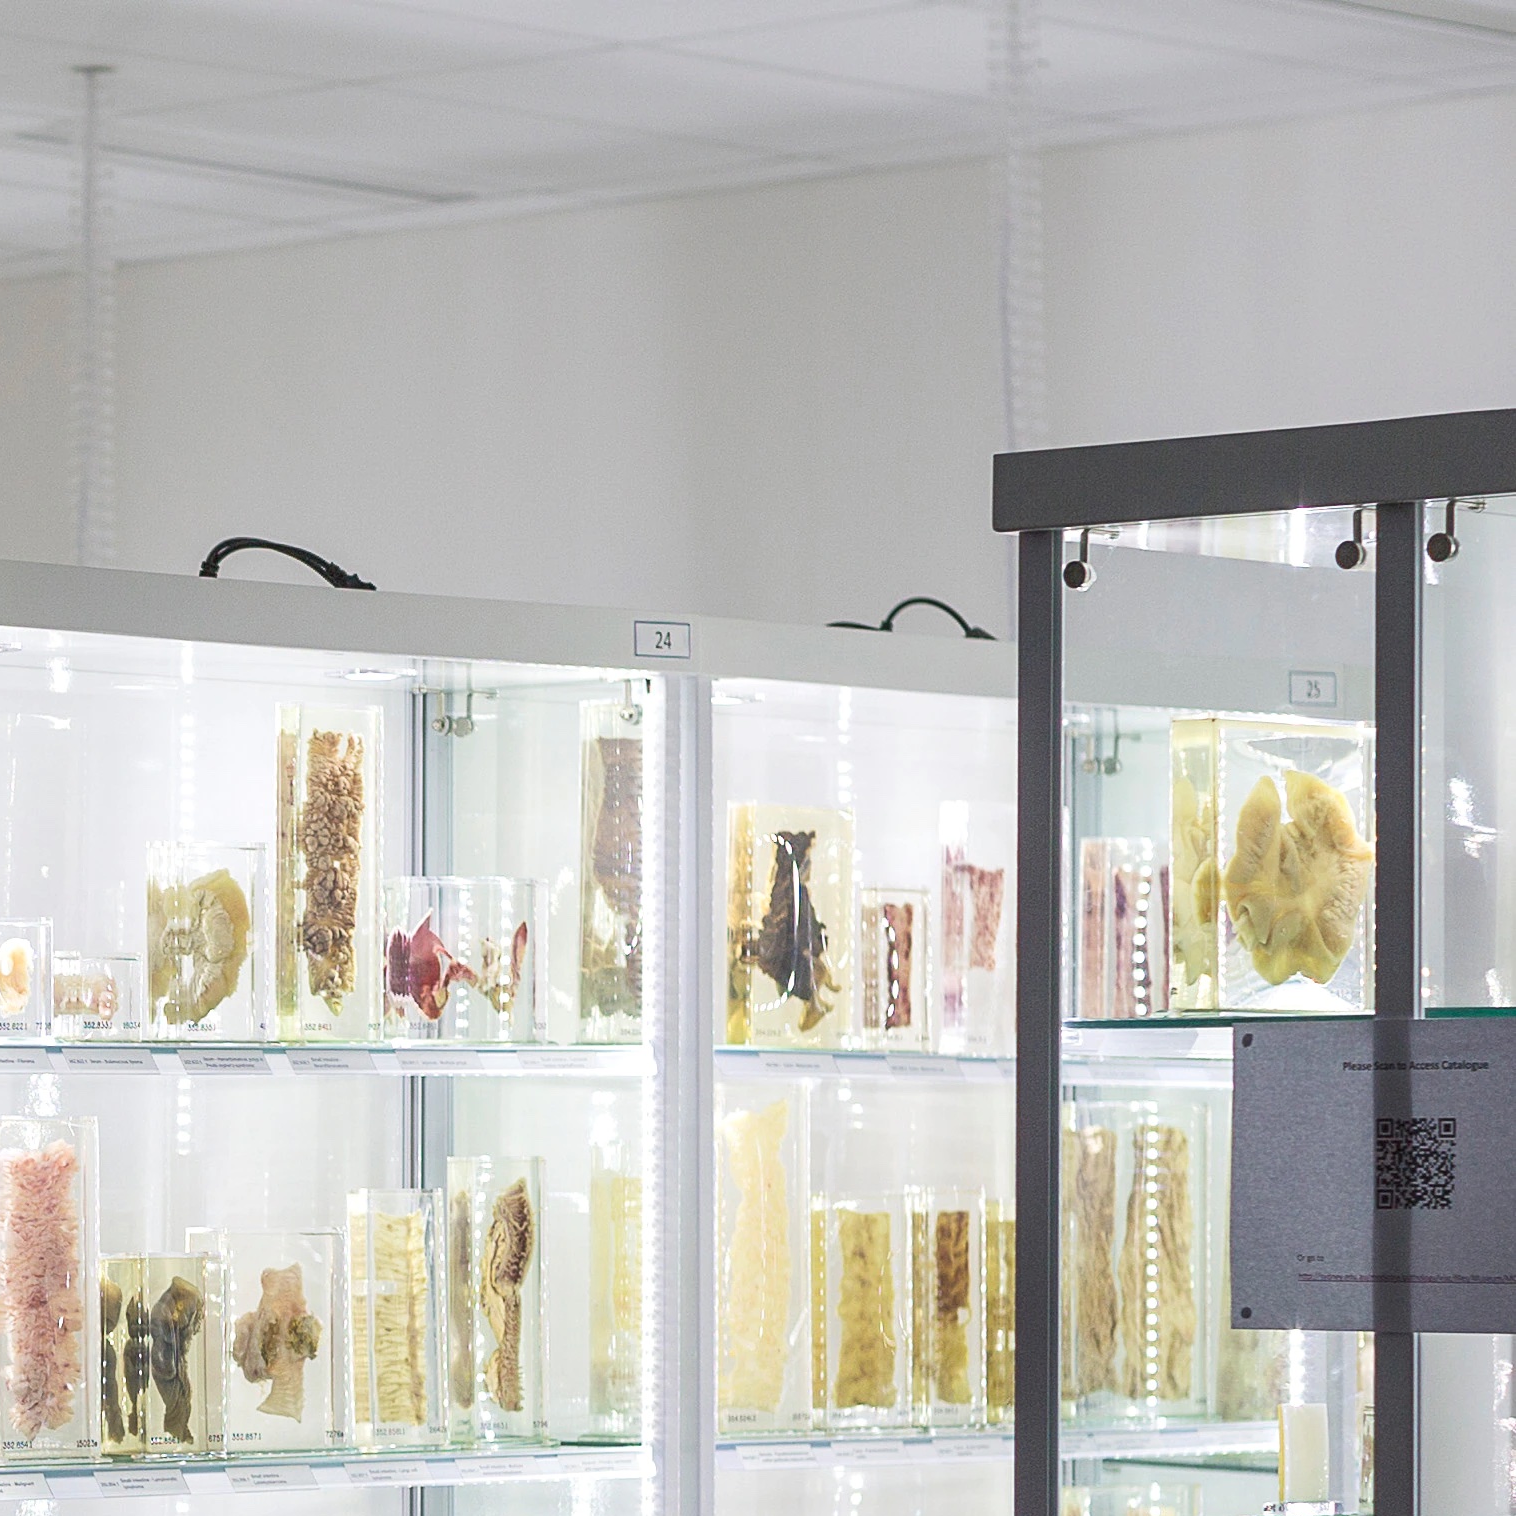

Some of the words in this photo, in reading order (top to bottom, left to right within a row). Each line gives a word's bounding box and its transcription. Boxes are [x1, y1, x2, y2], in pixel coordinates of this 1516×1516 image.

[654, 631, 672, 649] 24
[1343, 1060, 1372, 1071] Please
[1373, 1060, 1395, 1071] Scan
[1397, 1060, 1407, 1071] to
[1409, 1061, 1440, 1070] Access
[1441, 1060, 1490, 1072] Catalogue
